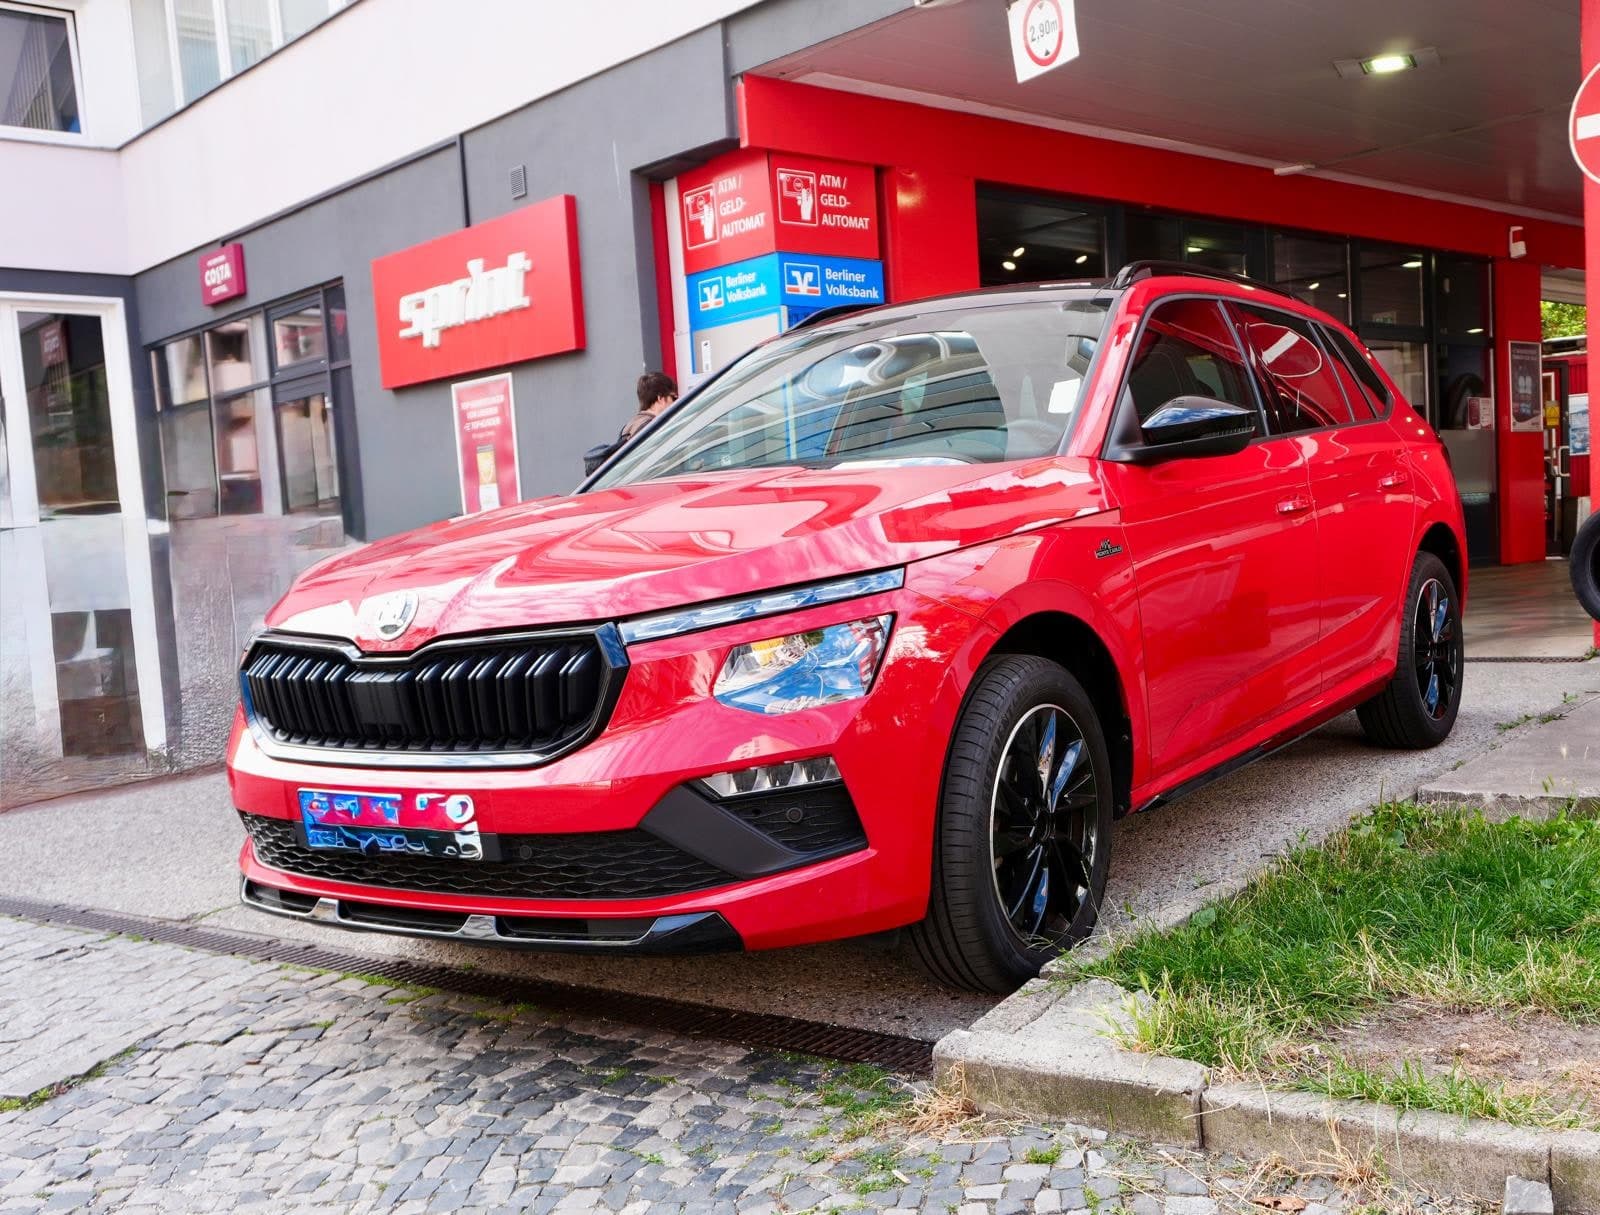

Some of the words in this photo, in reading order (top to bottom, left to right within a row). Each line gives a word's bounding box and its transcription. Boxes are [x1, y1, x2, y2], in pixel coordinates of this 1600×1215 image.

[718, 175, 737, 194] ATM
[819, 174, 841, 187] ATM
[719, 197, 746, 216] GELD-
[820, 193, 850, 208] GELD-
[721, 211, 765, 238] AUTOMAT
[821, 215, 870, 230] AUTOMAT
[204, 262, 233, 287] COSTA
[725, 271, 757, 289] Berliner
[825, 268, 866, 283] Berliner
[398, 250, 533, 349] sprint
[727, 283, 767, 303] Volksbank
[825, 284, 879, 300] Volksbank
